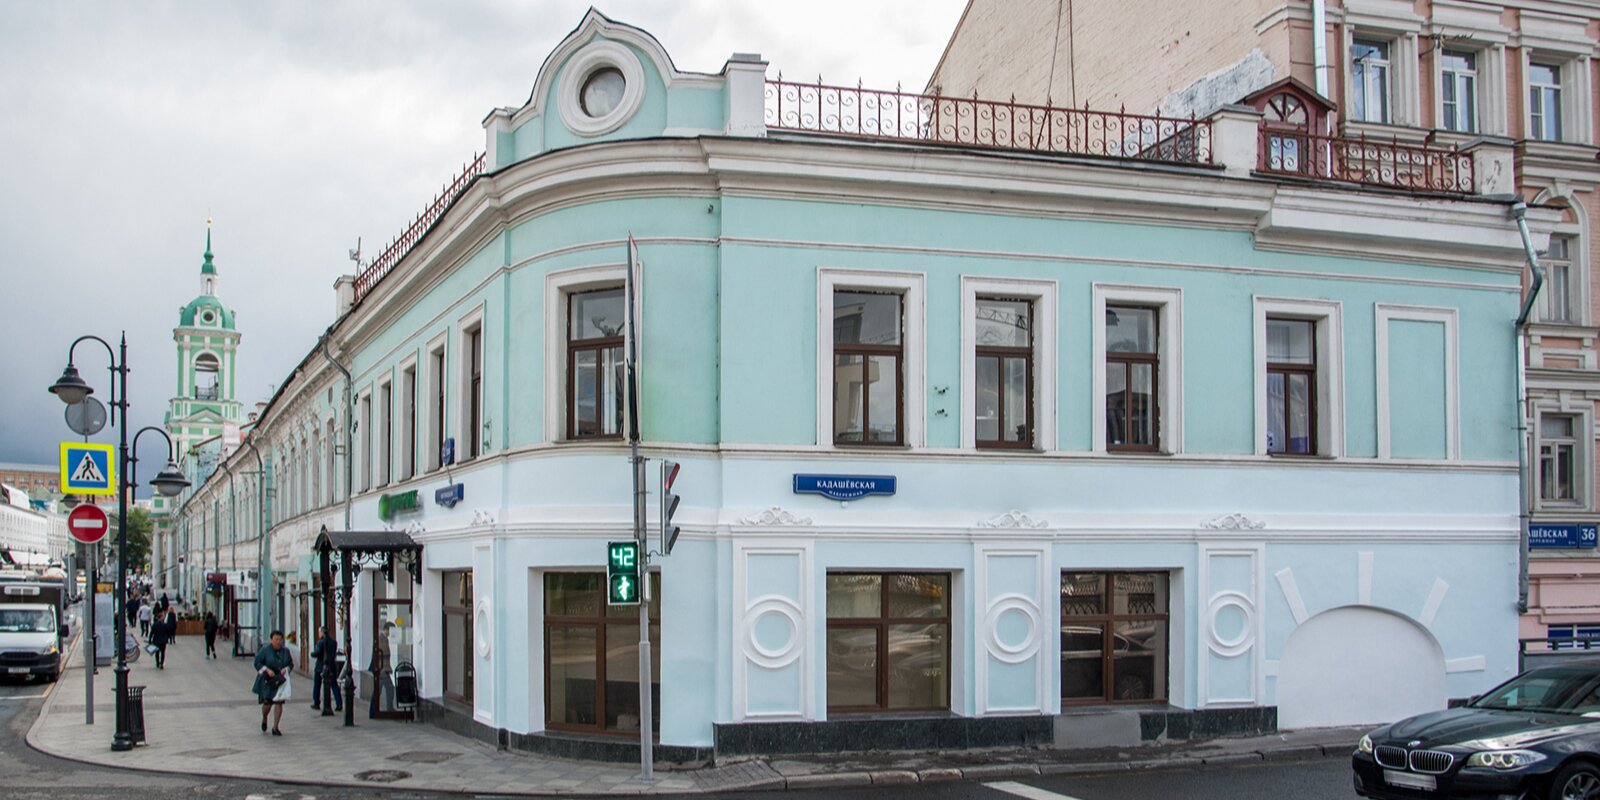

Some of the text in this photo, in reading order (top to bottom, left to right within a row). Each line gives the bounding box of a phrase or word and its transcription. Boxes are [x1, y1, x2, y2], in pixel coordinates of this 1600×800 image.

[816, 480, 875, 489] КАДАШЁВСКАЯ
[1581, 528, 1596, 540] 36
[612, 547, 634, 566] 42
